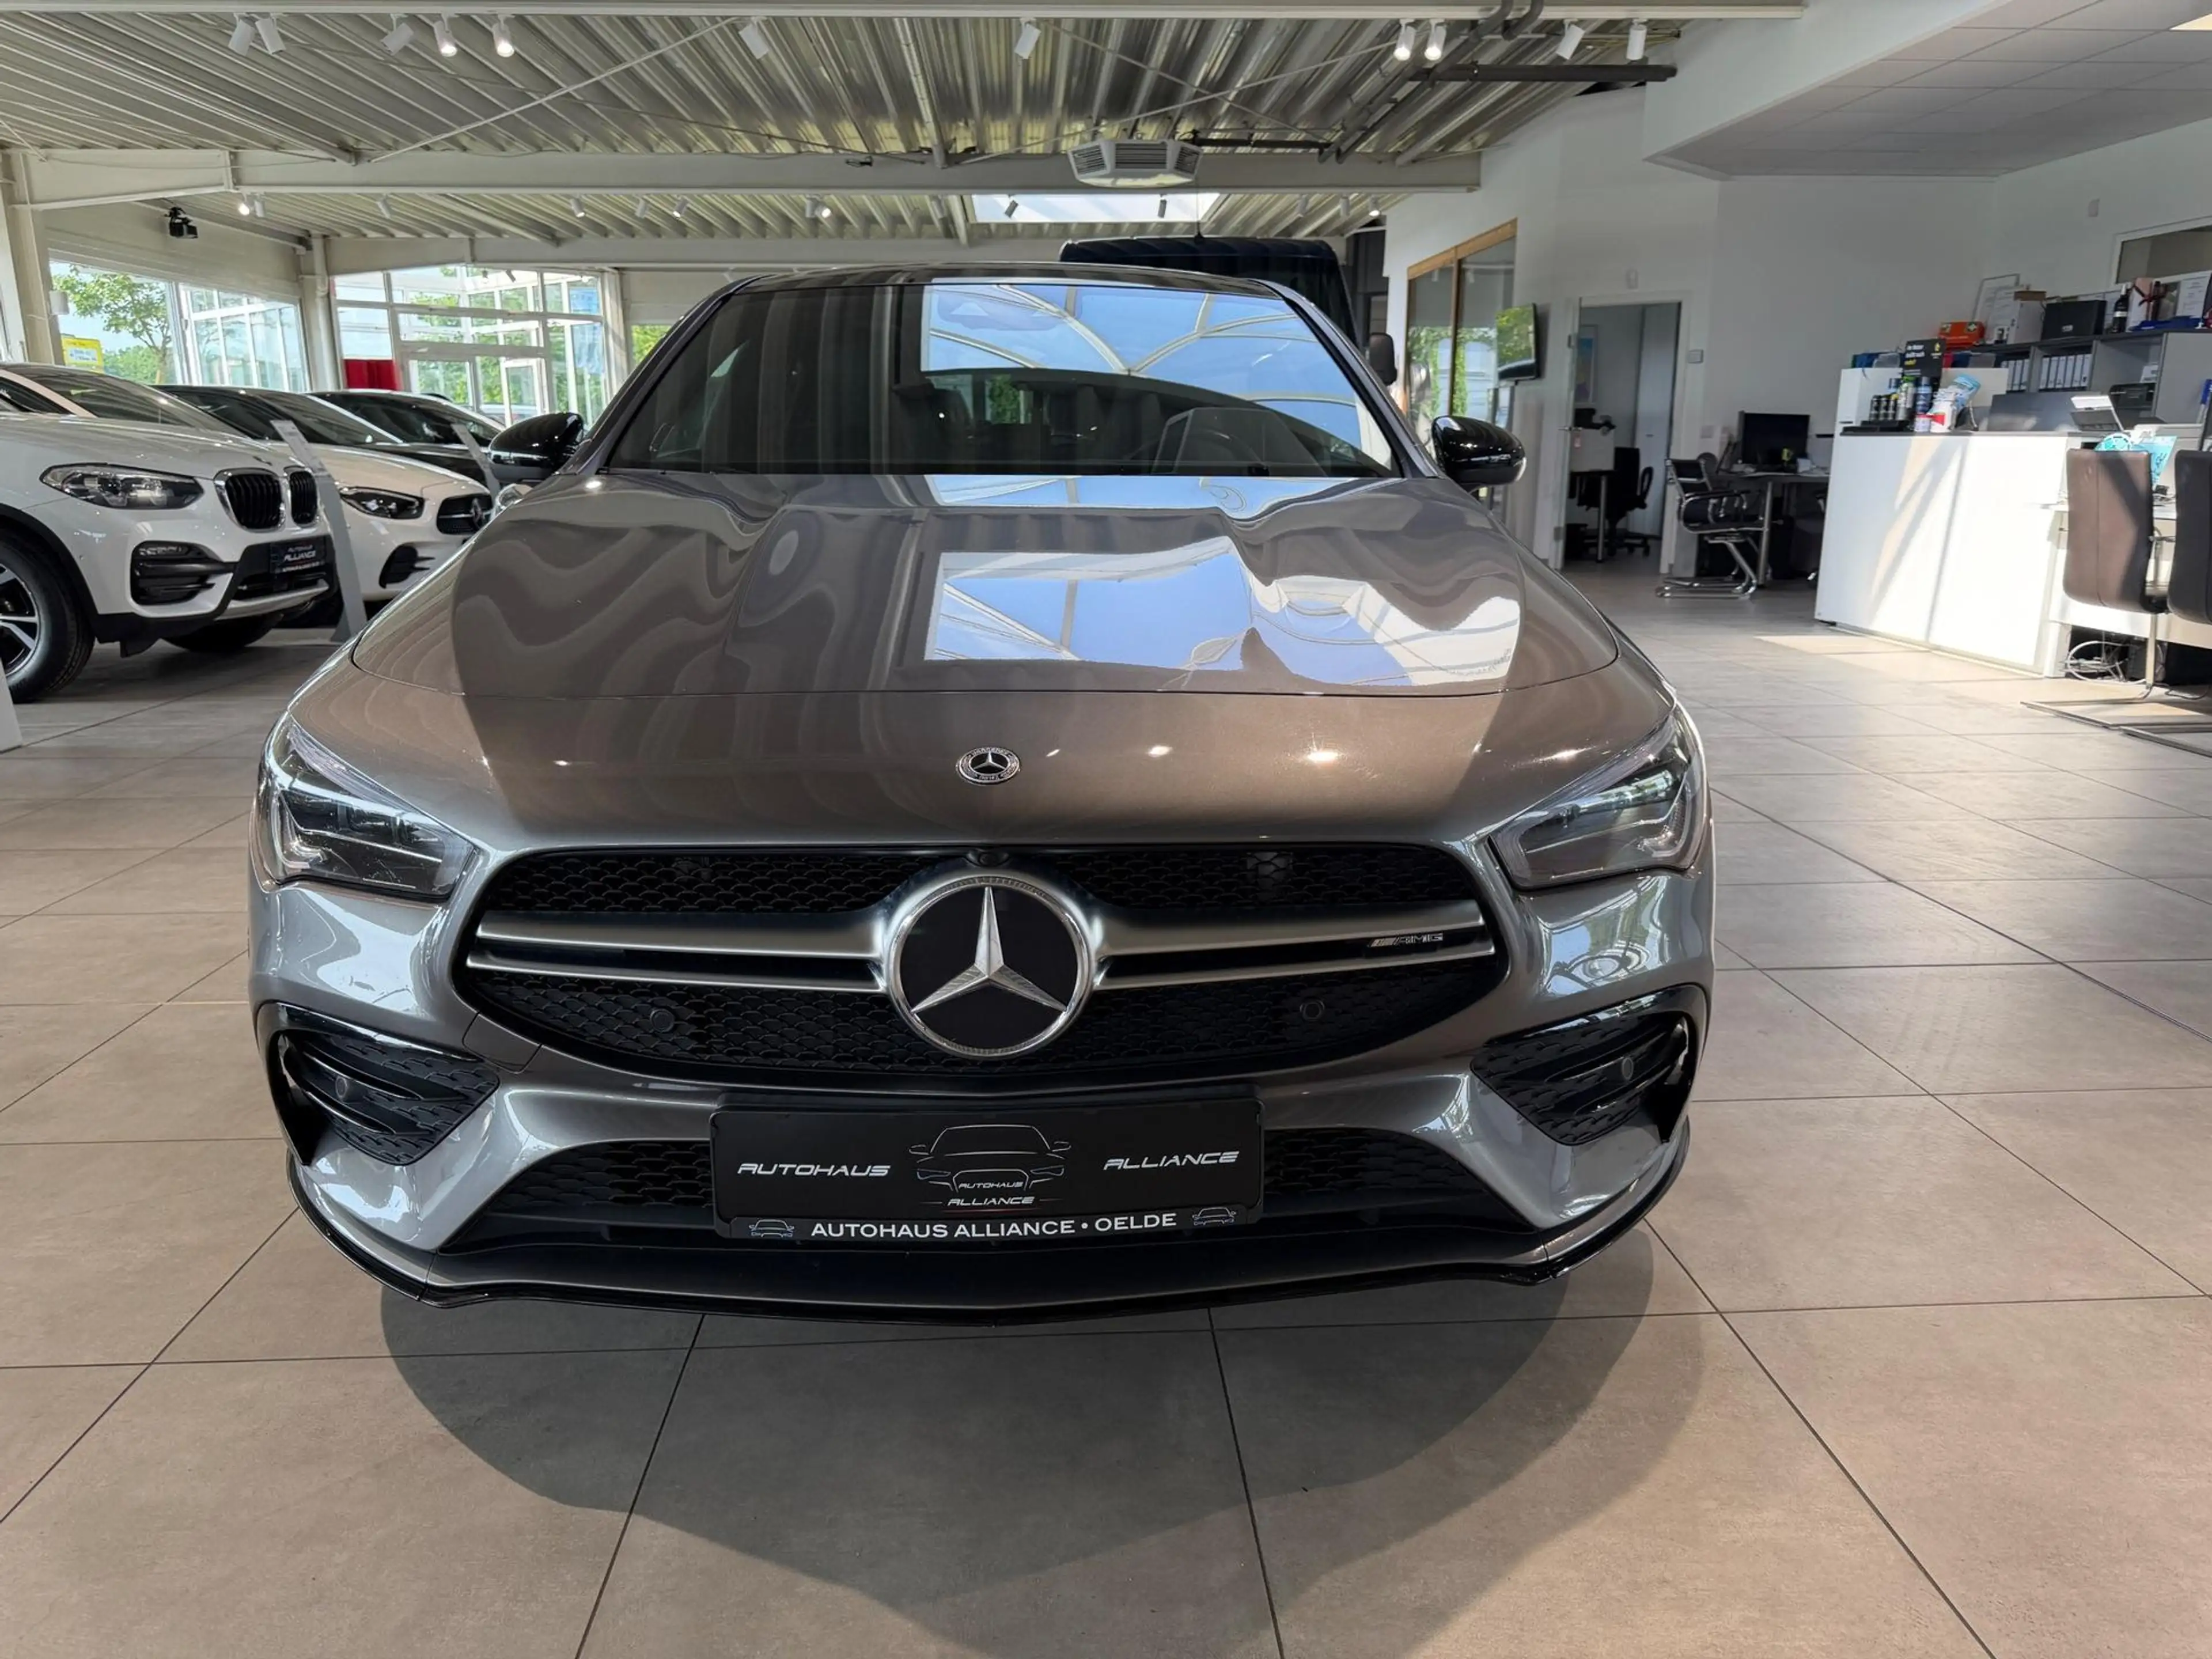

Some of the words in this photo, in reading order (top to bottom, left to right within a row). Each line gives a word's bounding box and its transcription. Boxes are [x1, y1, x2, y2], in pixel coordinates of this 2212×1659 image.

[1103, 1151, 1240, 1171] ALLIANCE
[737, 1163, 891, 1177] AUTOHAUS
[947, 1196, 1035, 1206] ALLIANCE
[811, 1223, 948, 1238] AUTOHAUS
[953, 1219, 1075, 1238] ALLIANCE
[1094, 1213, 1177, 1232] OELDE
